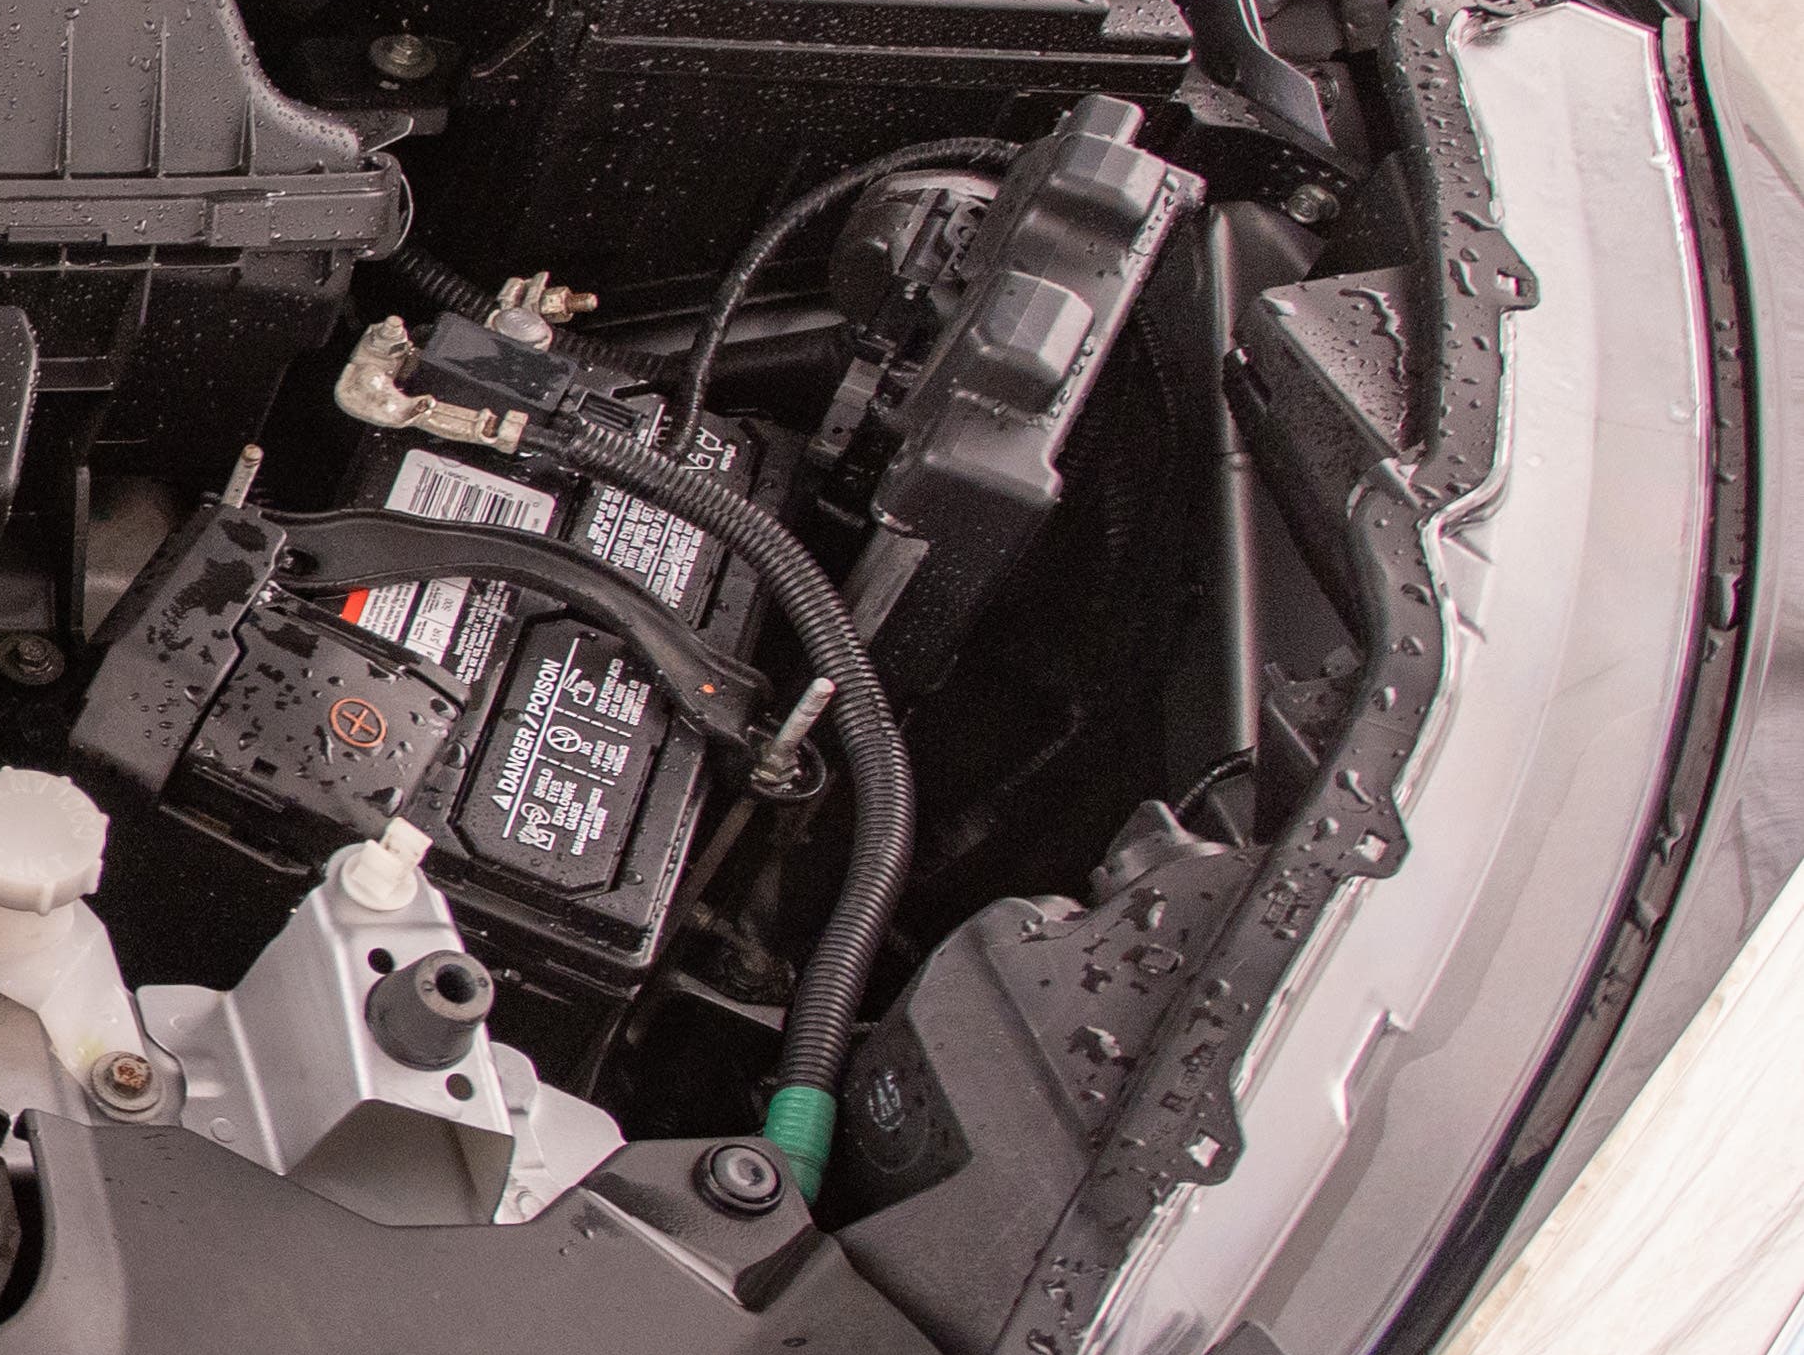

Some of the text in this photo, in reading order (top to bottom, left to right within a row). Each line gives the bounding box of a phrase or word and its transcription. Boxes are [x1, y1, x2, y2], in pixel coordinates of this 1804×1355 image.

[622, 546, 640, 569] WITH
[639, 505, 655, 523] GET
[646, 521, 664, 543] HELP
[594, 657, 624, 714] SULFURIC ACID
[496, 725, 538, 794] DANGER
[524, 657, 563, 716] POISON
[579, 740, 593, 755] NO
[532, 767, 554, 799] SHIELD
[544, 778, 563, 803] EYES
[550, 780, 578, 826] EXPLOSIVE
[563, 800, 585, 831] GASES
